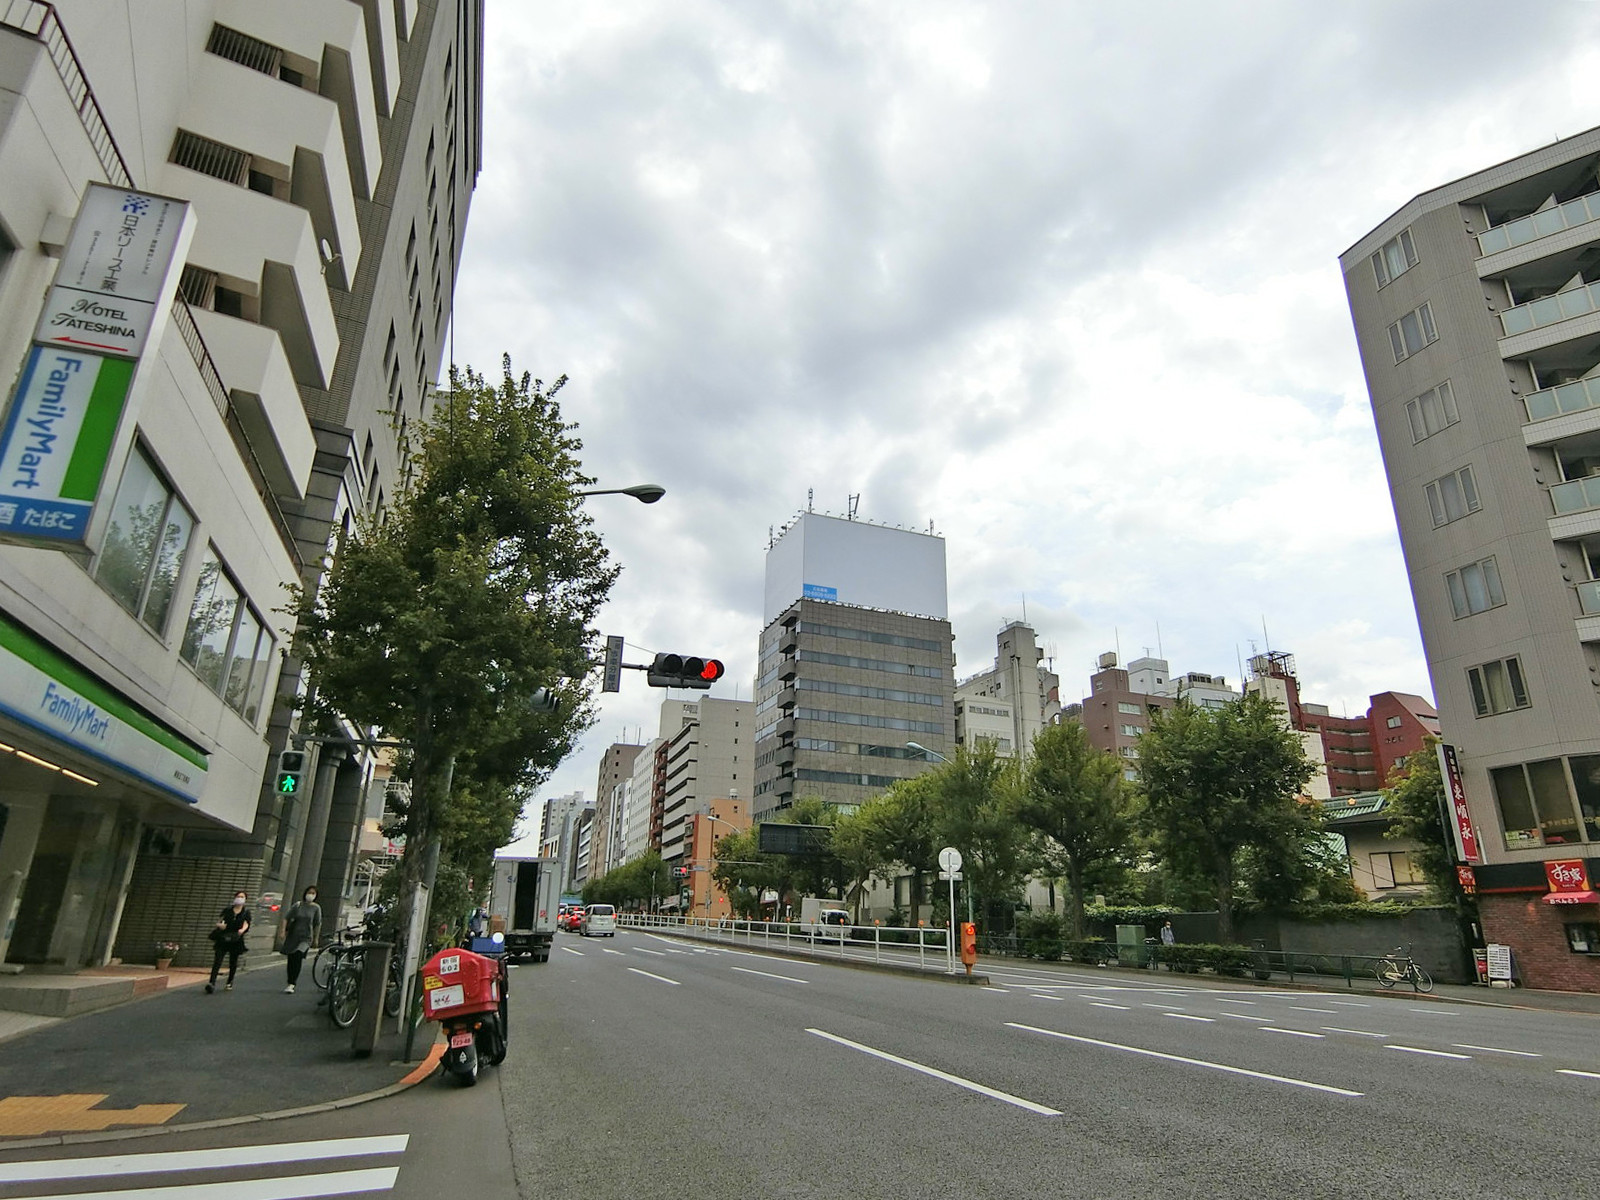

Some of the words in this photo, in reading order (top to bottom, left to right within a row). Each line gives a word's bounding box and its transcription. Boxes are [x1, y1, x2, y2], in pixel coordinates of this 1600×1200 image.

[71, 298, 128, 321] HOTEL
[51, 312, 136, 339] TATESHINA
[12, 356, 82, 490] FamilyMart
[22, 507, 76, 530] たばこ
[40, 681, 110, 741] FamilyMart
[1551, 863, 1583, 884] すき家
